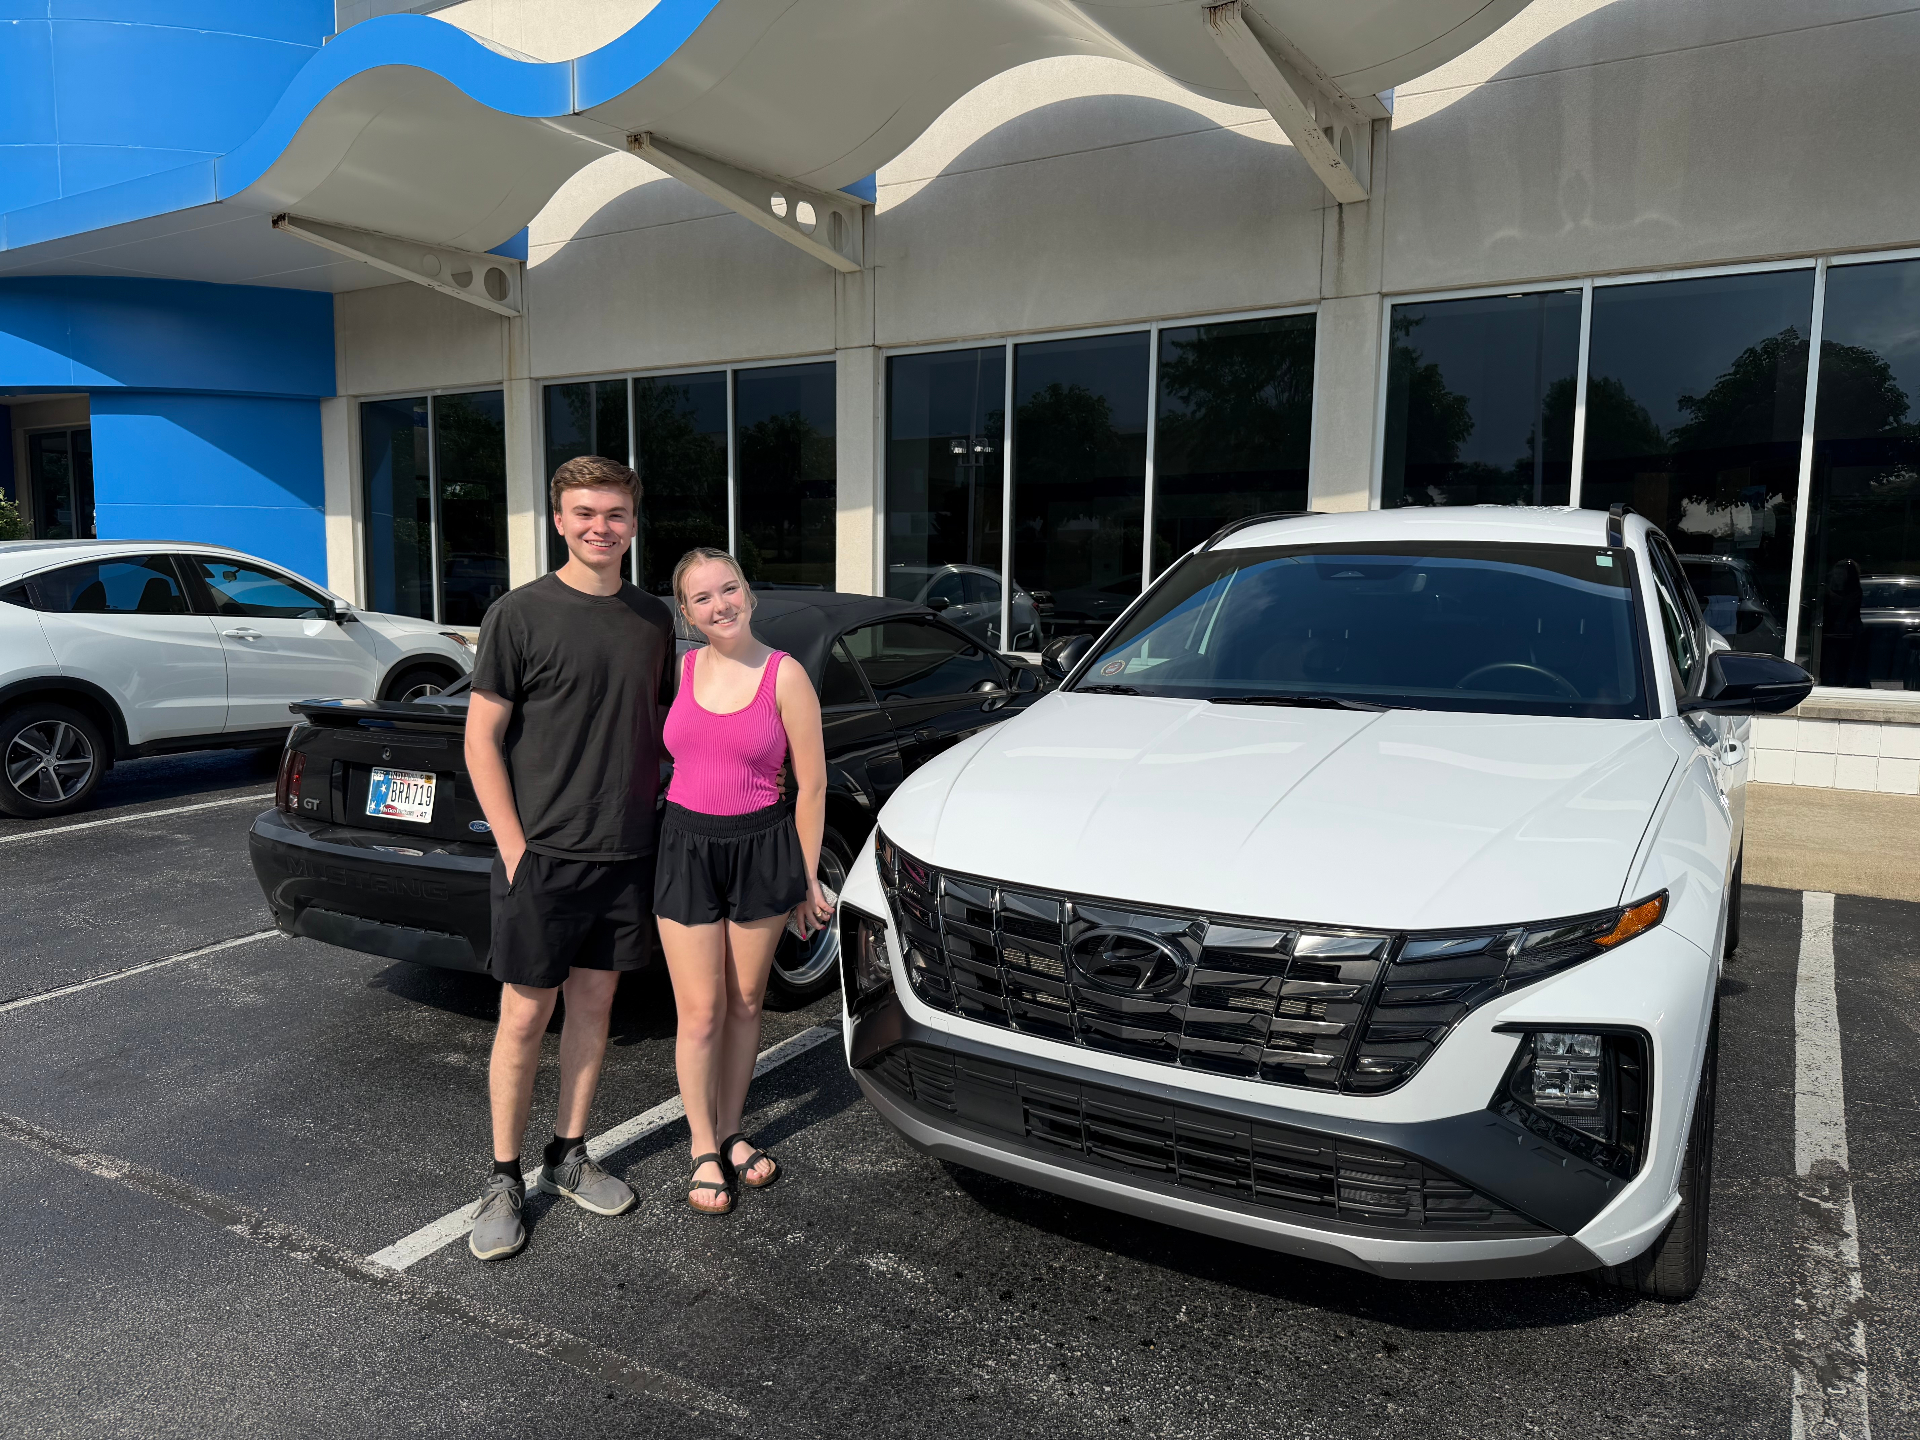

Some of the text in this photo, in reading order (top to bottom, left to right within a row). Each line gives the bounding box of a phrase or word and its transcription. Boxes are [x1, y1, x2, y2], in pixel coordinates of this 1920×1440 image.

[303, 797, 320, 811] GT
[390, 780, 433, 807] BRA719
[286, 856, 449, 901] MUSTANG
